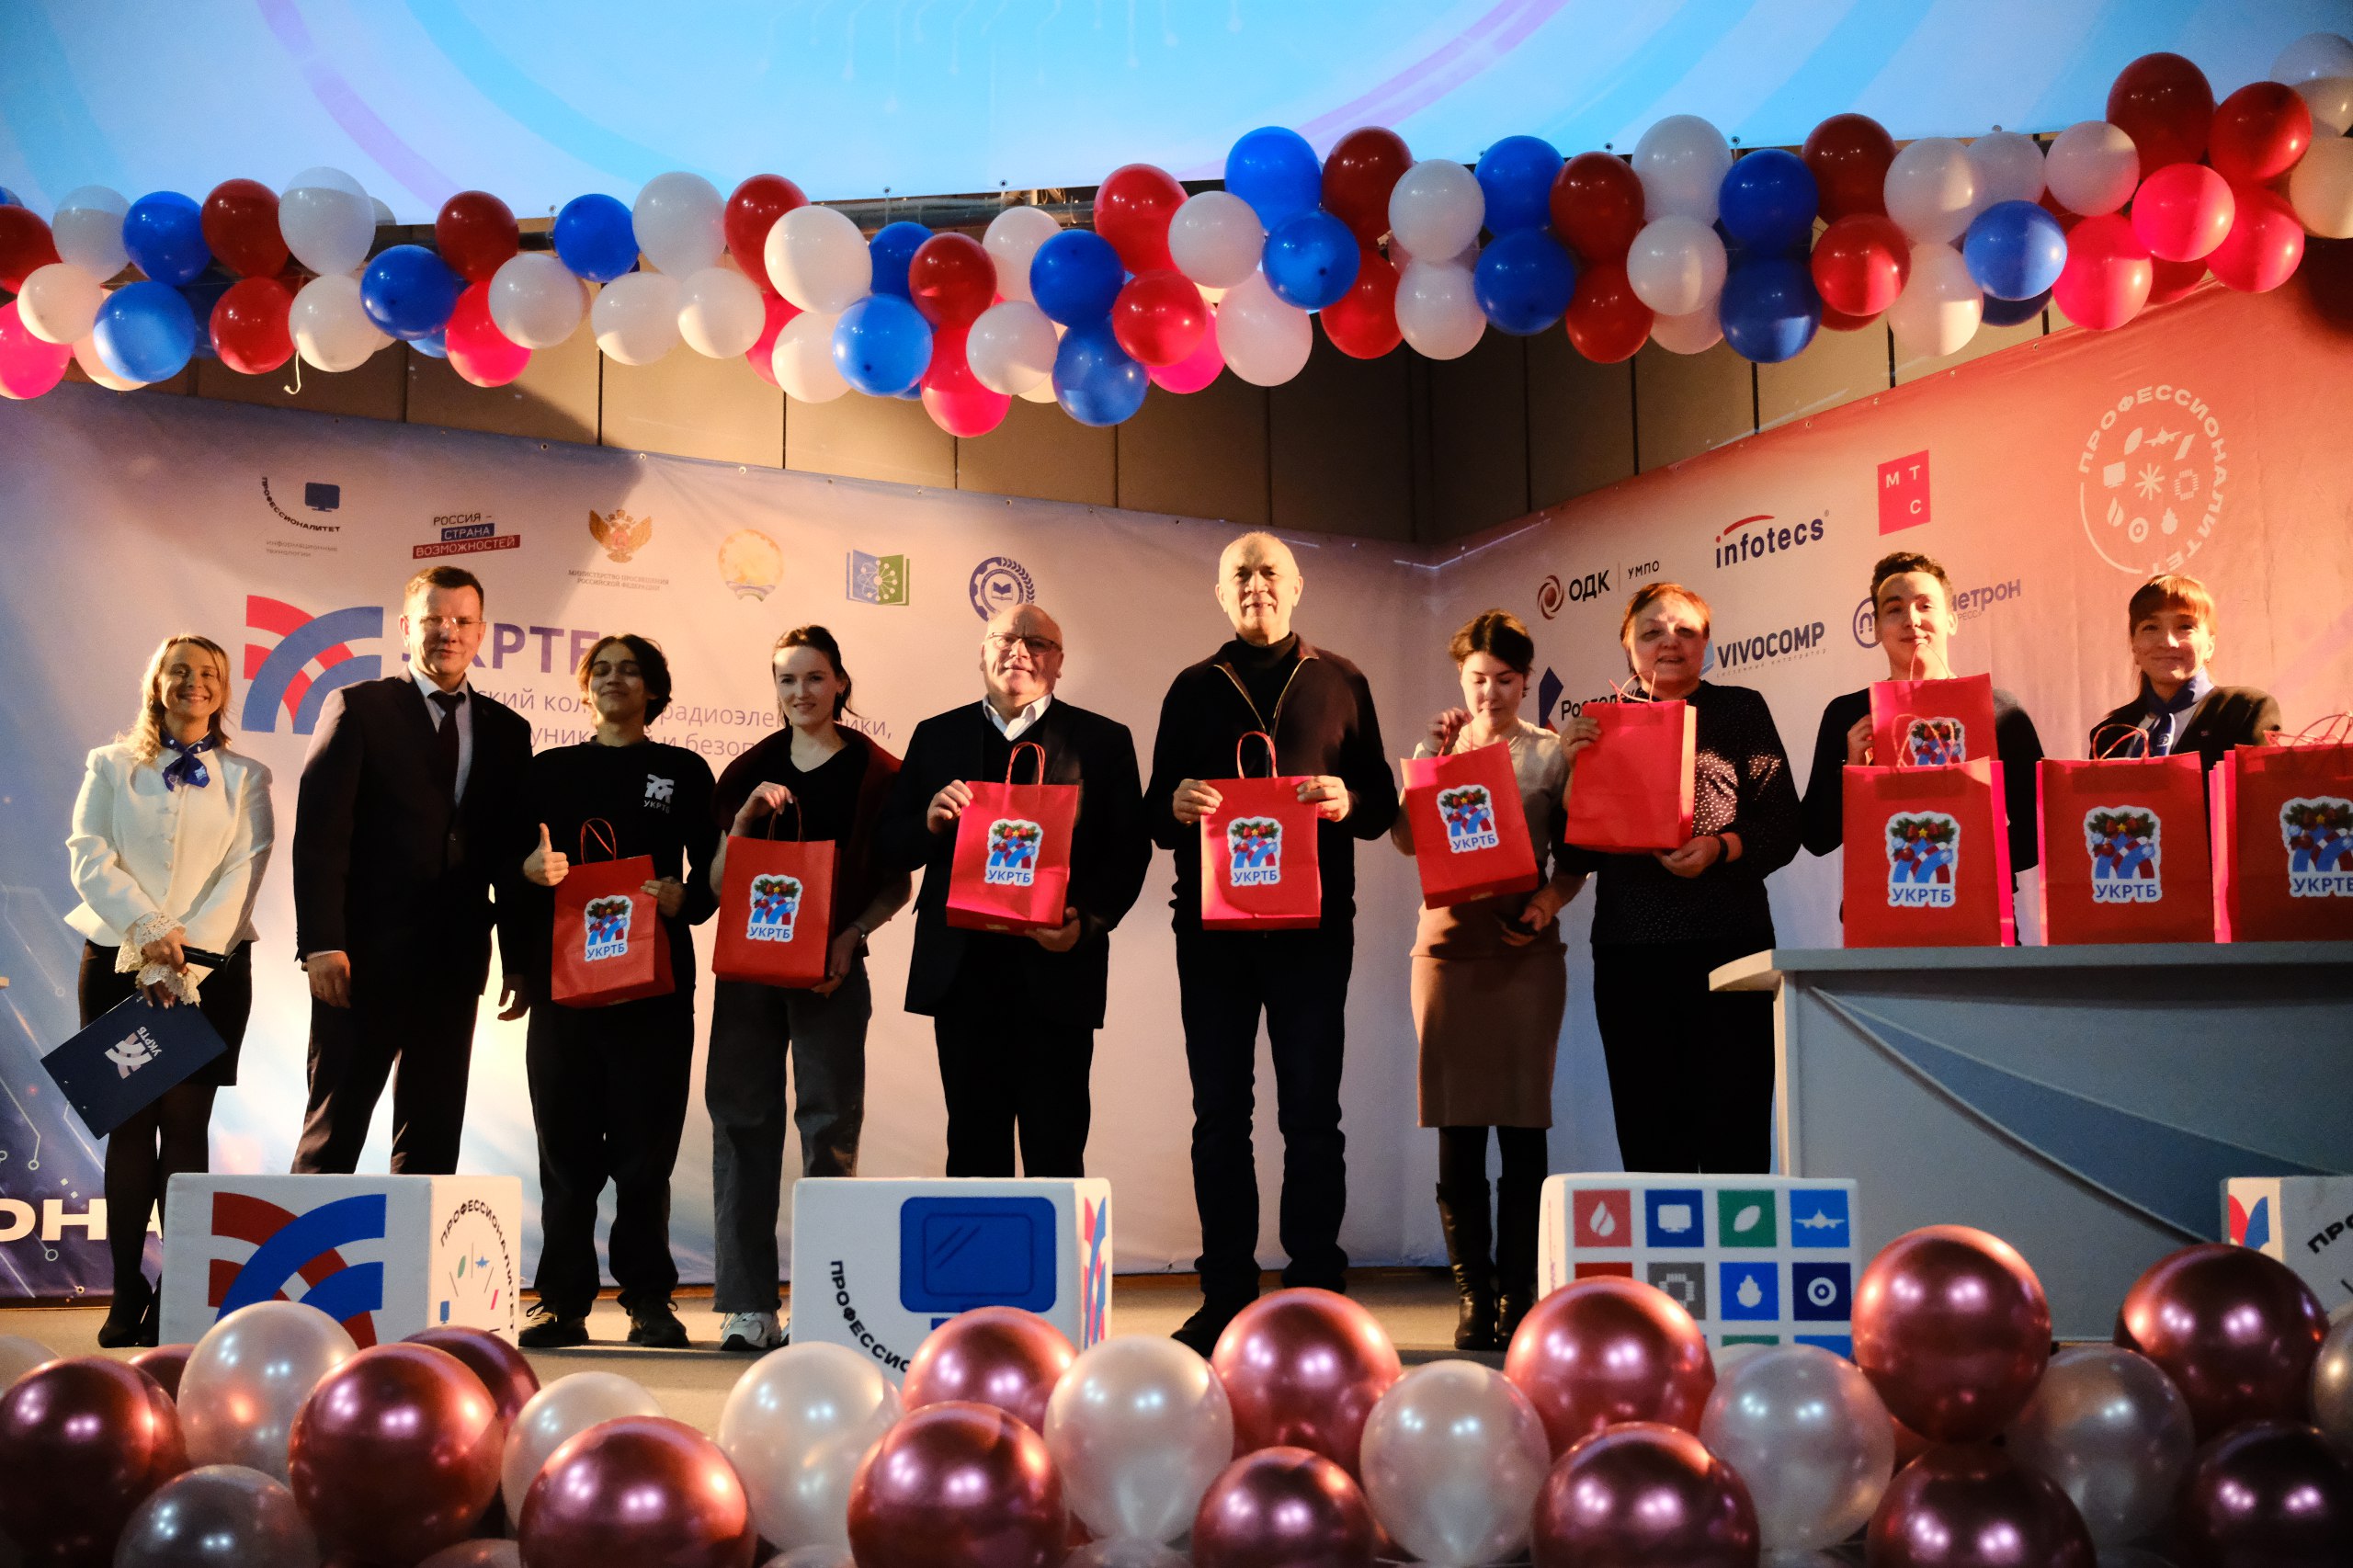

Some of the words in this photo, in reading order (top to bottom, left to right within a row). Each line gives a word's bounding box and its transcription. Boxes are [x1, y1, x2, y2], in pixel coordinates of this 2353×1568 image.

[262, 476, 341, 532] ПРОФЕССИОНАЛИТЕТ
[433, 513, 482, 527] РОССИЯ
[443, 526, 491, 540] СТРАНА
[415, 536, 516, 557] ВОЗМОЖНОСТЕЙ
[1715, 518, 1824, 569] infotecs
[1568, 570, 1610, 602] ОДК
[1628, 560, 1660, 580] УМПО
[1717, 621, 1825, 669] VIVOCOMP
[1453, 834, 1495, 850] УКРТБ
[987, 869, 1031, 883] УКРТБ
[1233, 869, 1278, 883] УКРТБ
[1892, 888, 1951, 903] УКРТБ
[2096, 883, 2157, 899] УКРТБ
[749, 926, 791, 939] УКРТБ
[586, 943, 626, 959] УКРТБ
[137, 1026, 163, 1057] УКРТБ
[440, 1199, 516, 1335] ПРОФЕССИОНАЛИТЕТ
[831, 1259, 912, 1373] ПРОФЕССИО
